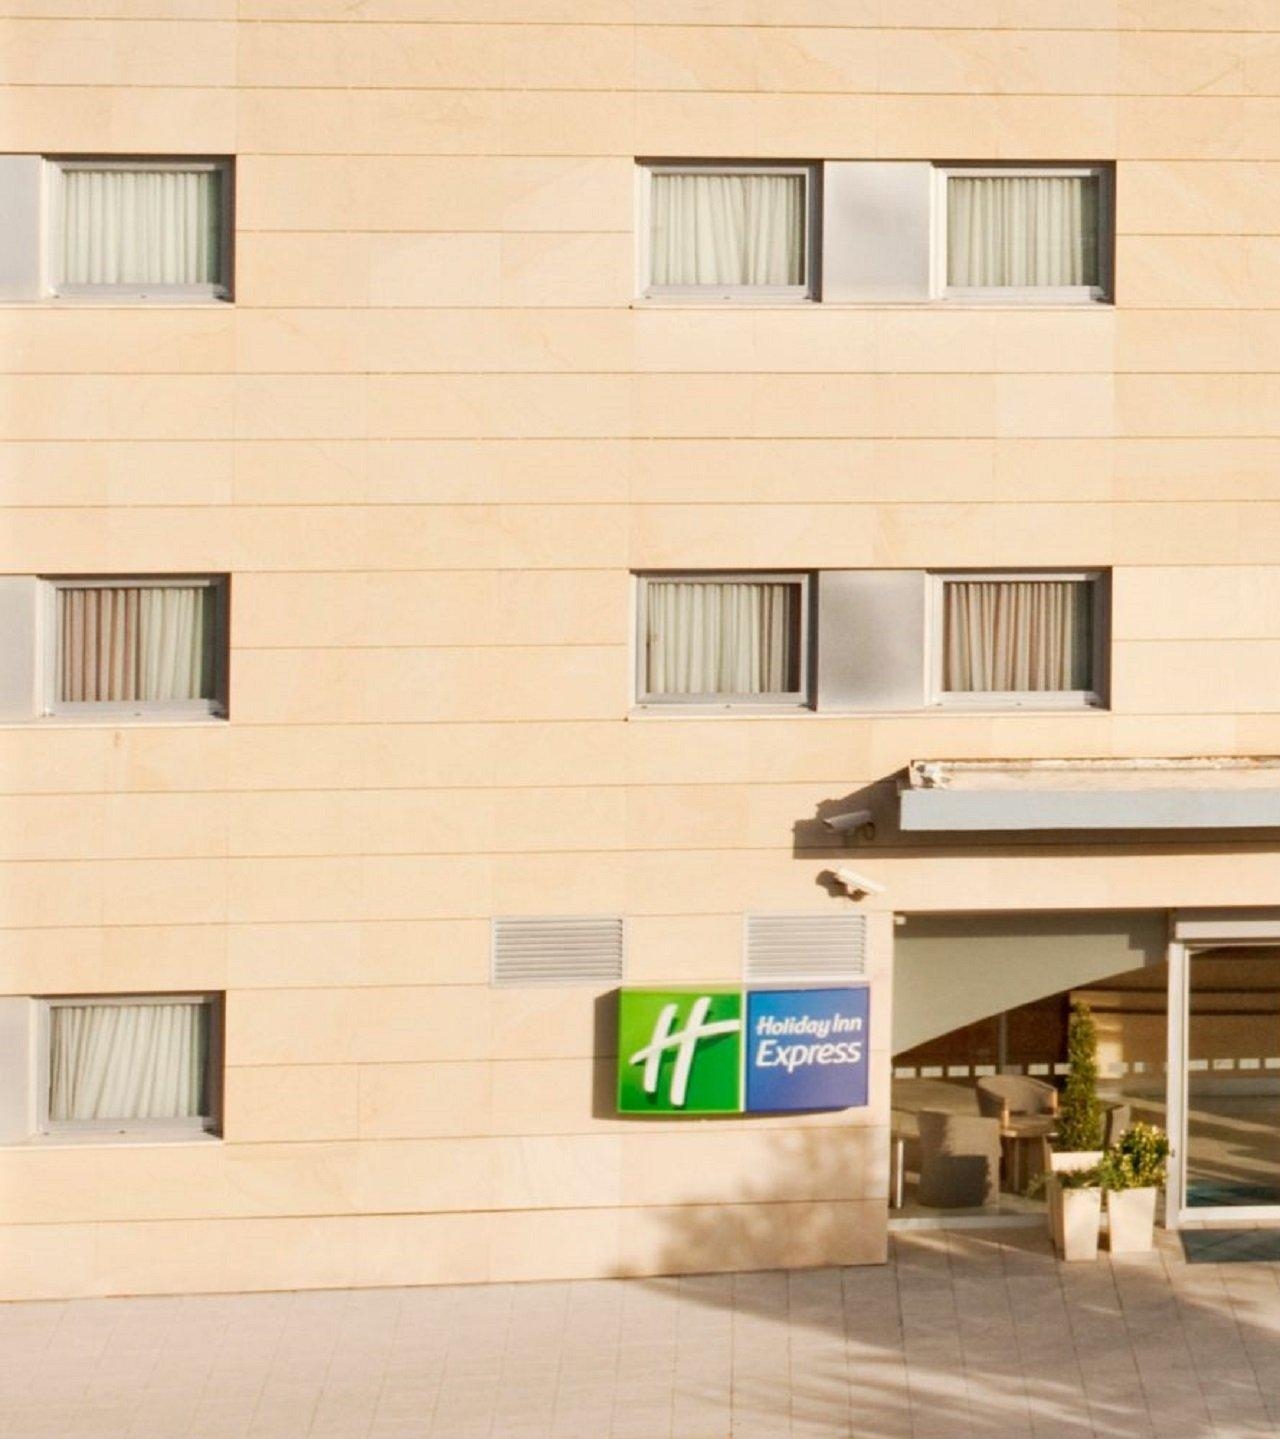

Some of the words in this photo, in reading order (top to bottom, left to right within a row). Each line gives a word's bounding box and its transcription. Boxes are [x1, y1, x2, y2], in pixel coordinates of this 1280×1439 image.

[756, 1015, 832, 1038] Holiday
[832, 1013, 862, 1033] Inn
[756, 1039, 862, 1073] Express
